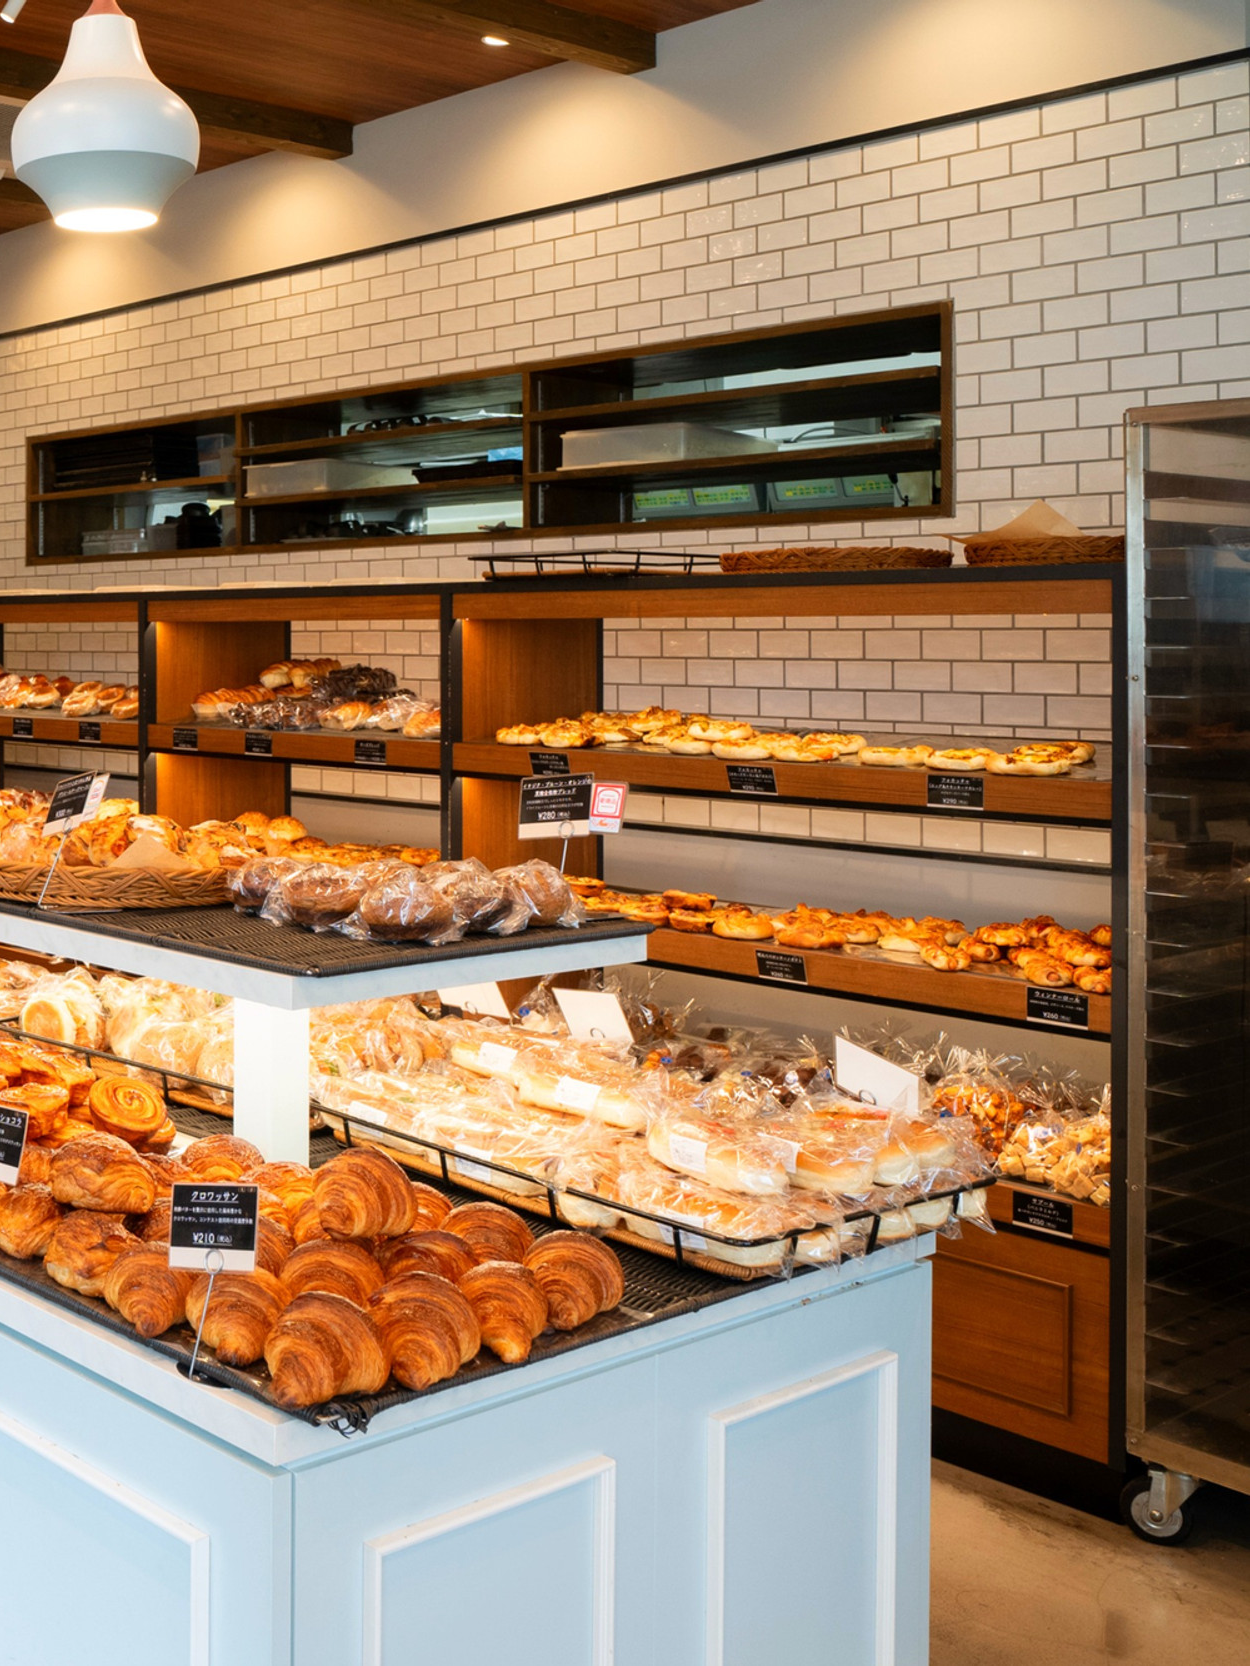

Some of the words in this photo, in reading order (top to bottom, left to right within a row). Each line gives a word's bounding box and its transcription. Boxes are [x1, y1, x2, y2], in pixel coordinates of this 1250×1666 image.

[191, 1190, 239, 1202] クロワッサン
[193, 1232, 215, 1244] ¥210
